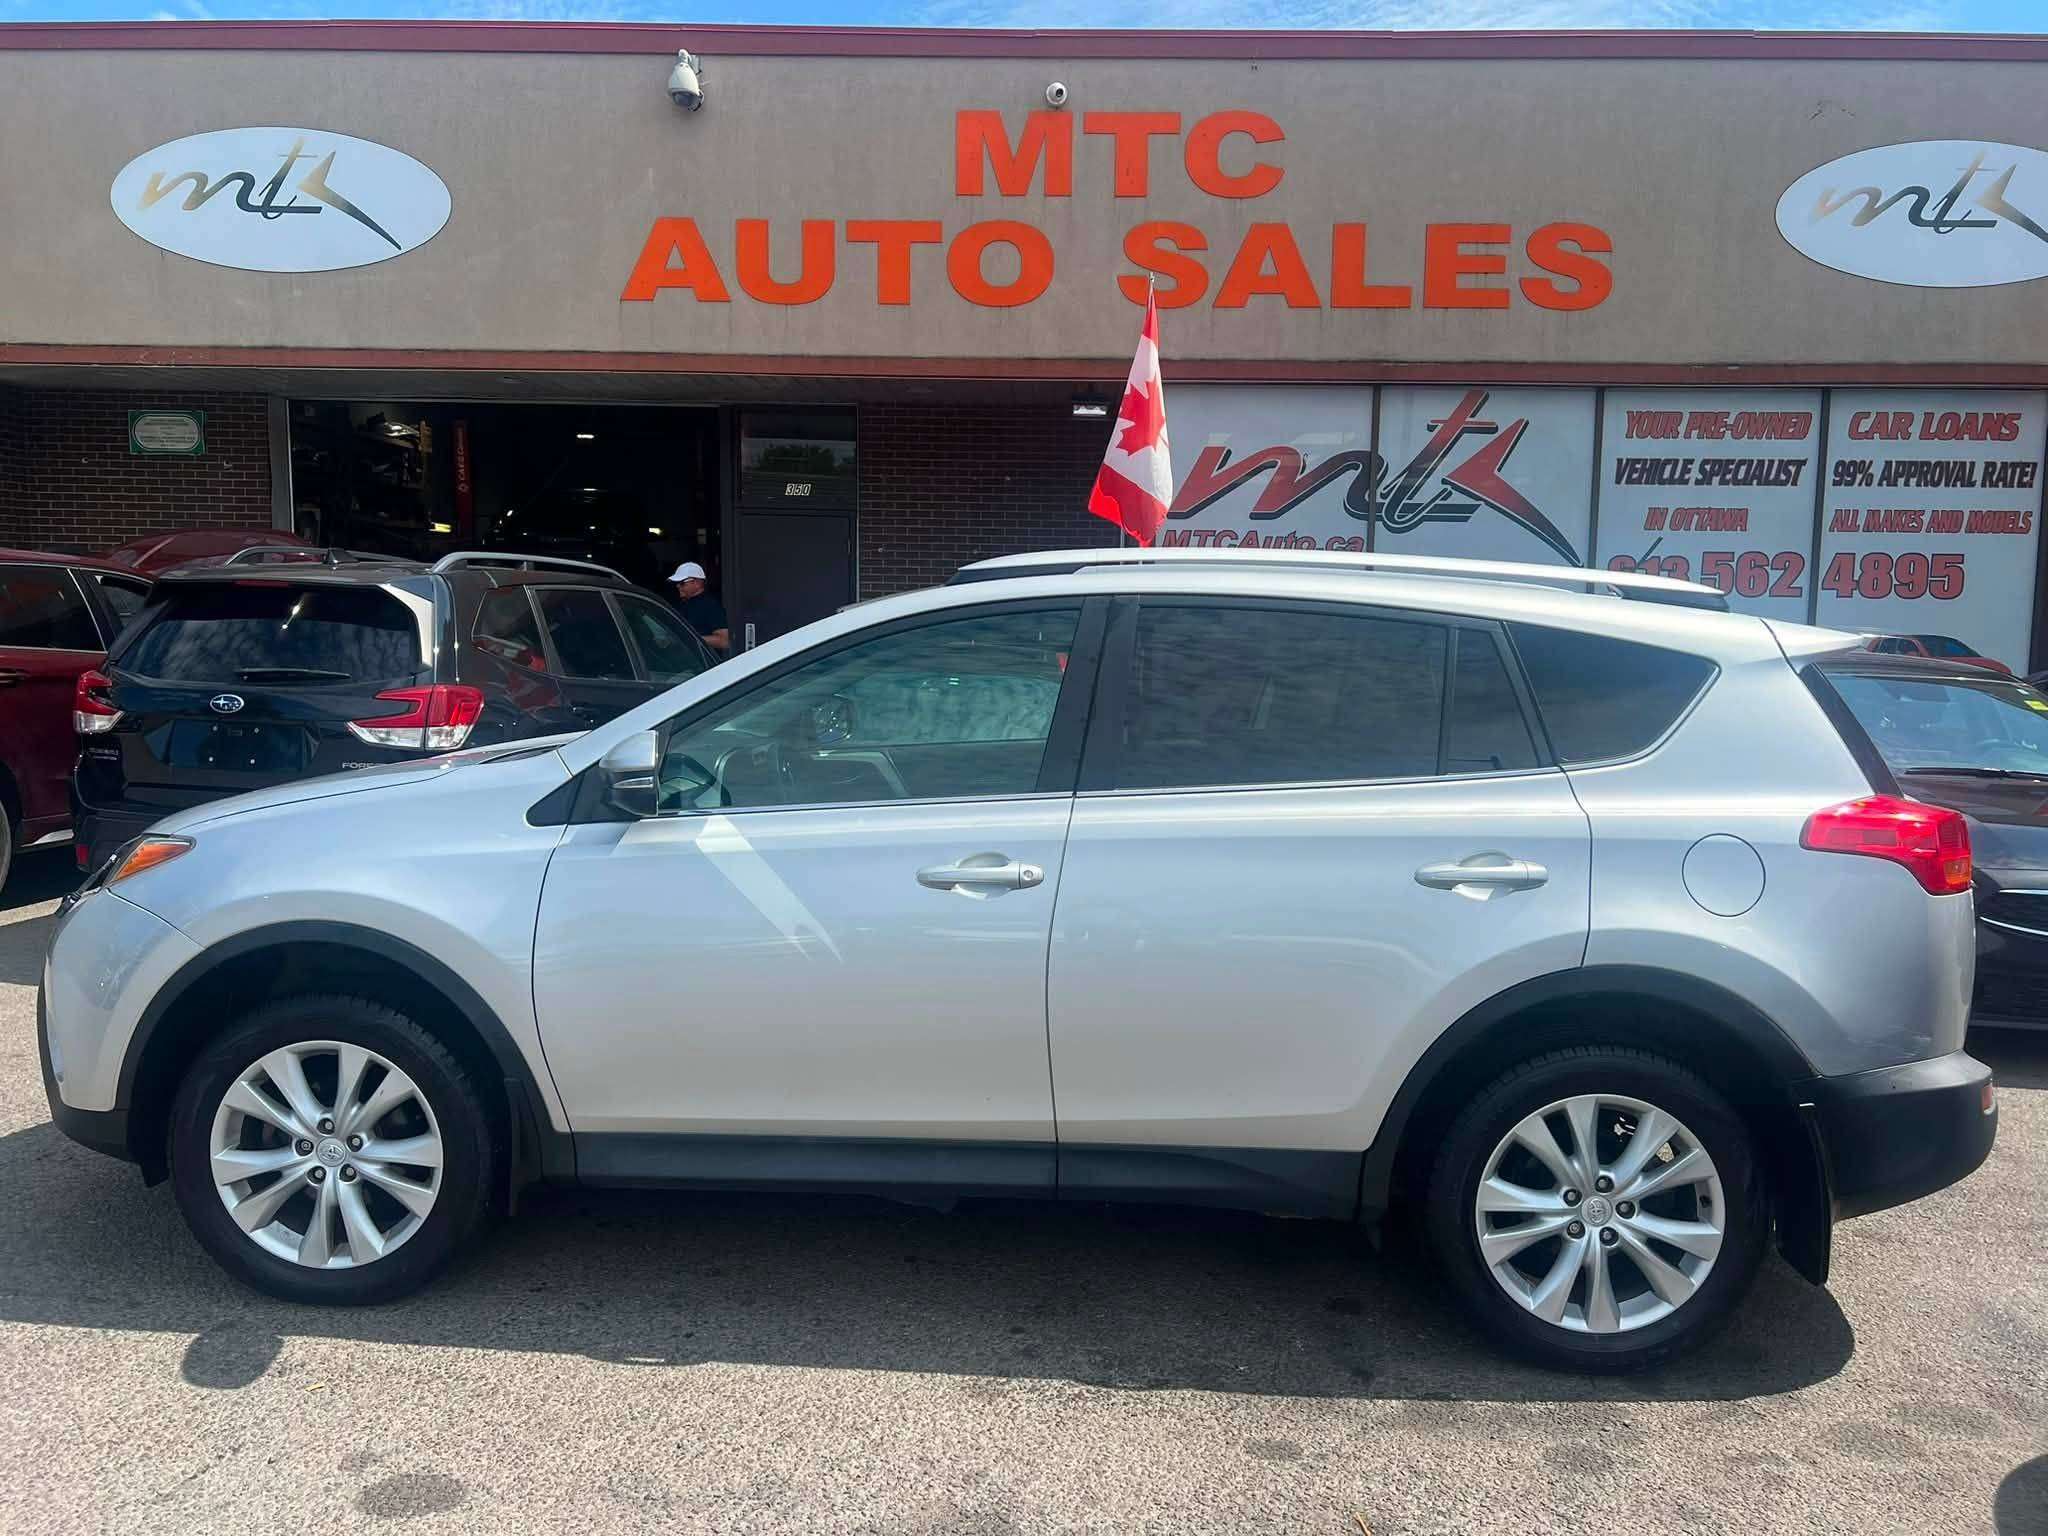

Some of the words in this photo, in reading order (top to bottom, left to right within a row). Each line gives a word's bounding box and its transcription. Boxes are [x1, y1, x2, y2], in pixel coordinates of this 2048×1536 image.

[955, 109, 1286, 199] MTC
[620, 217, 1056, 308] AUTO
[1116, 220, 1614, 312] SALES
[1625, 410, 1684, 440] YOUR
[1683, 411, 1813, 441] PRE-OWNED
[1847, 411, 1915, 441] CAR
[1918, 411, 2023, 442] LOANS
[1615, 457, 1696, 486] VEHICLE
[1694, 457, 1809, 487] SPECIALIST
[1832, 459, 1875, 487] 99%
[1876, 460, 1977, 488] APPROVAL
[1980, 460, 2039, 489] RATE!
[785, 483, 812, 496] 350
[1643, 506, 1670, 532] IN
[1669, 507, 1750, 532] OTTAWA
[1828, 508, 1861, 533] ALL
[1861, 509, 1925, 534] MAKES
[1925, 509, 1966, 534] AND
[1964, 510, 2034, 535] MODELS
[1700, 551, 1806, 599] 562
[1821, 552, 1966, 600] 4895
